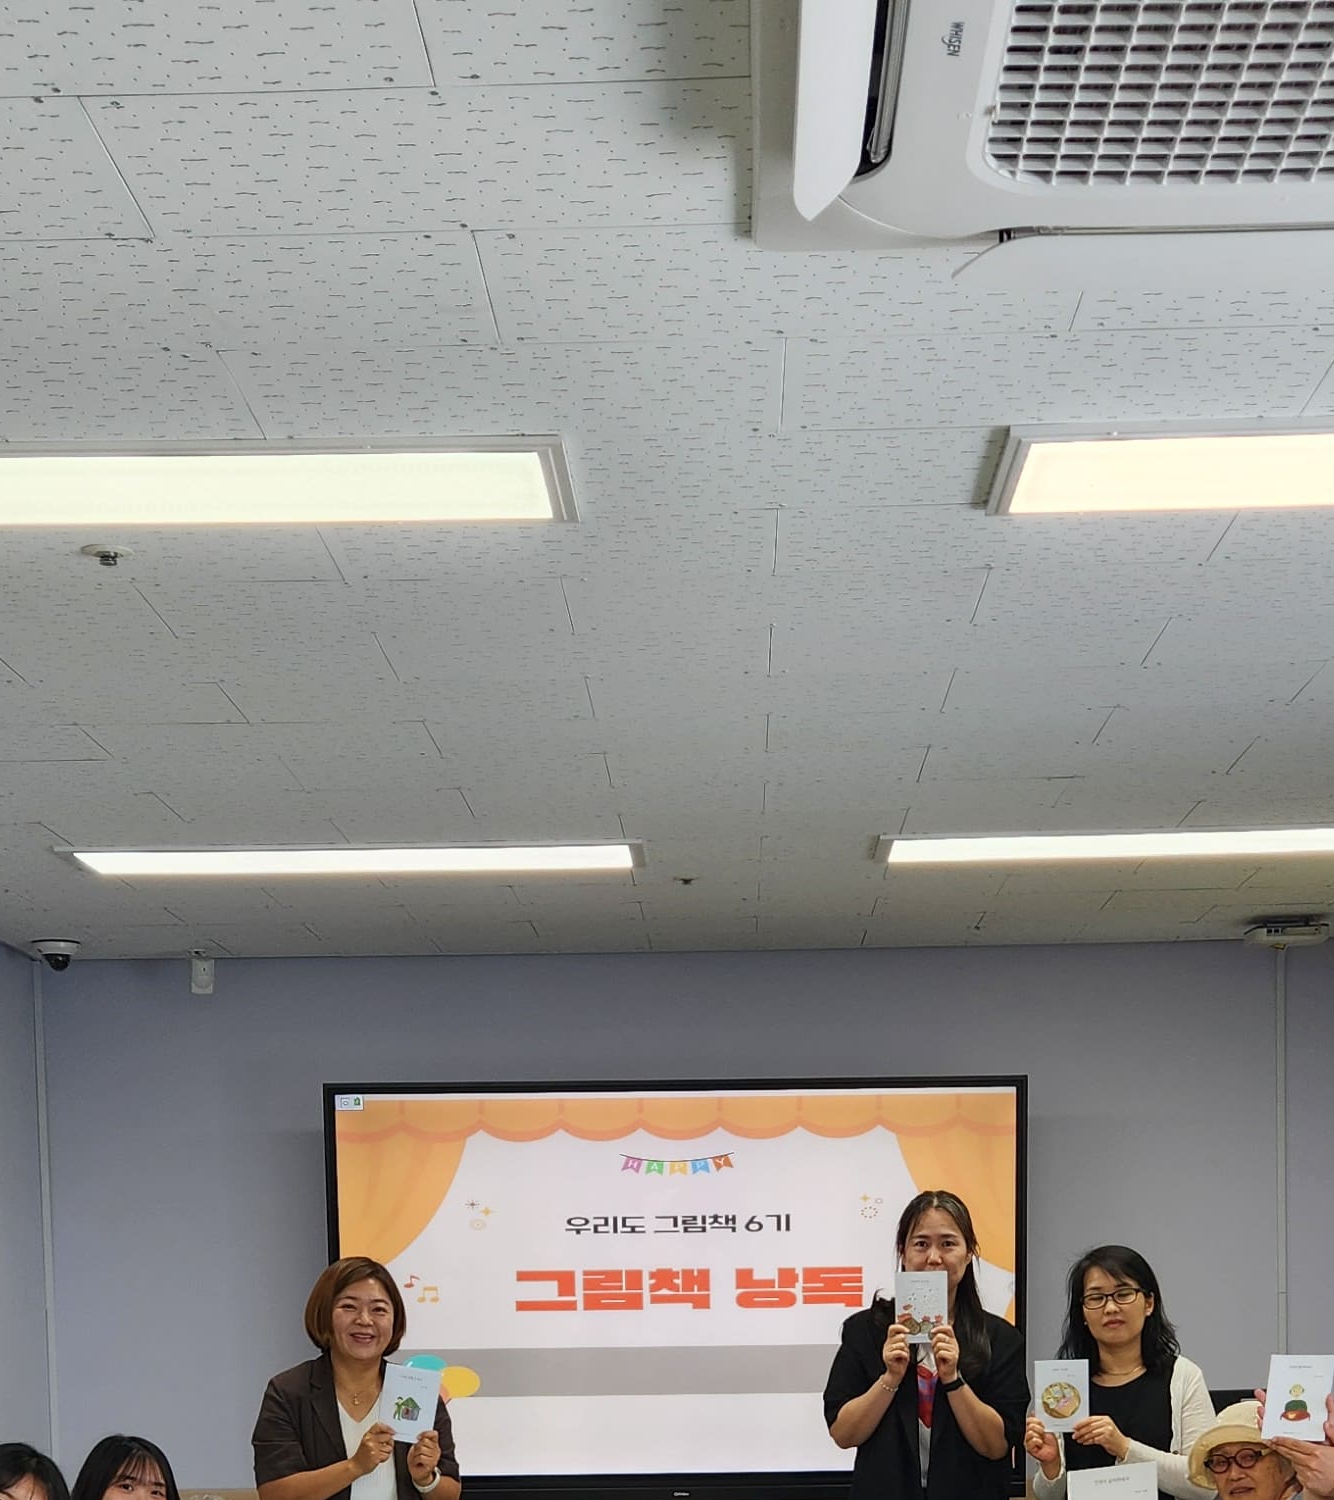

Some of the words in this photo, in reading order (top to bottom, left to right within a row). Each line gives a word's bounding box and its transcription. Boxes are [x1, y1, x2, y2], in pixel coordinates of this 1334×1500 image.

[941, 21, 966, 57] WHISEN
[626, 1156, 727, 1172] HAPPY
[564, 1215, 647, 1235] 우리도
[653, 1213, 737, 1234] 그림책
[744, 1213, 791, 1233] 6기
[515, 1267, 711, 1312] 그림책
[734, 1266, 864, 1309] 낭독
